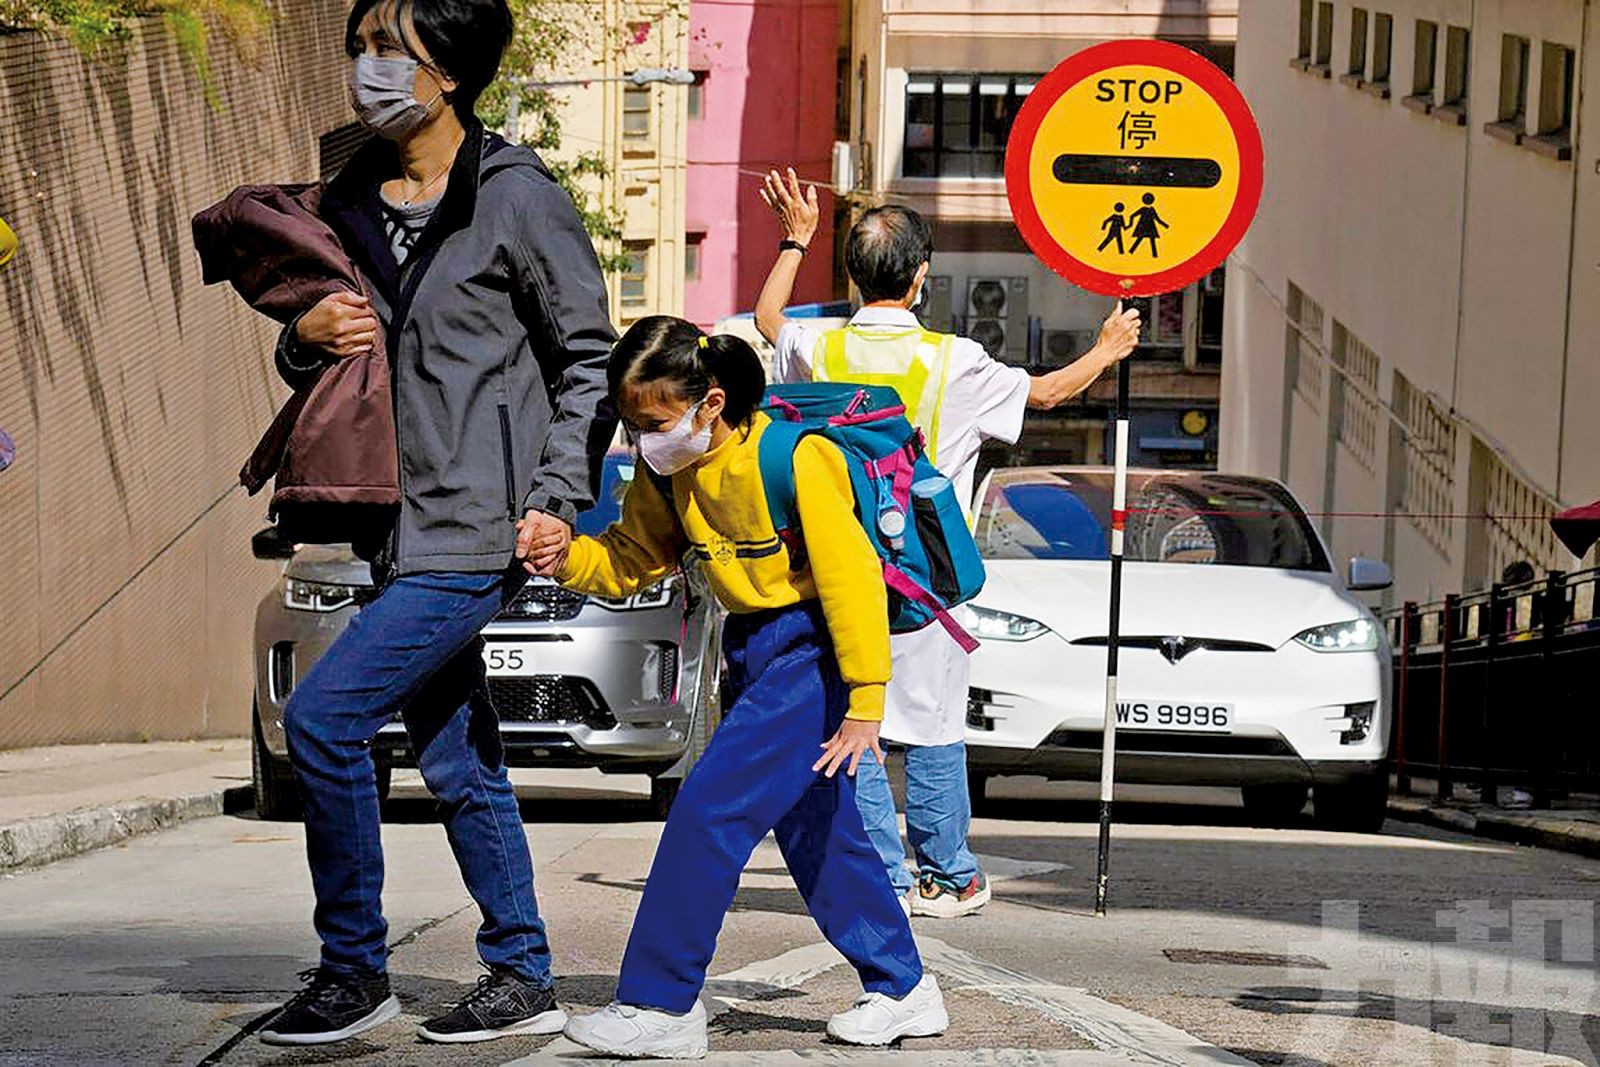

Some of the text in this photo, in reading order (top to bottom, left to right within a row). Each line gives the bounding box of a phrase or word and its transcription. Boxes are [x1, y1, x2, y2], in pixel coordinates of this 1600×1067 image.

[1095, 79, 1182, 104] STOP
[1117, 110, 1156, 149] 停
[489, 649, 523, 670] 55
[1115, 703, 1228, 726] WS 9996
